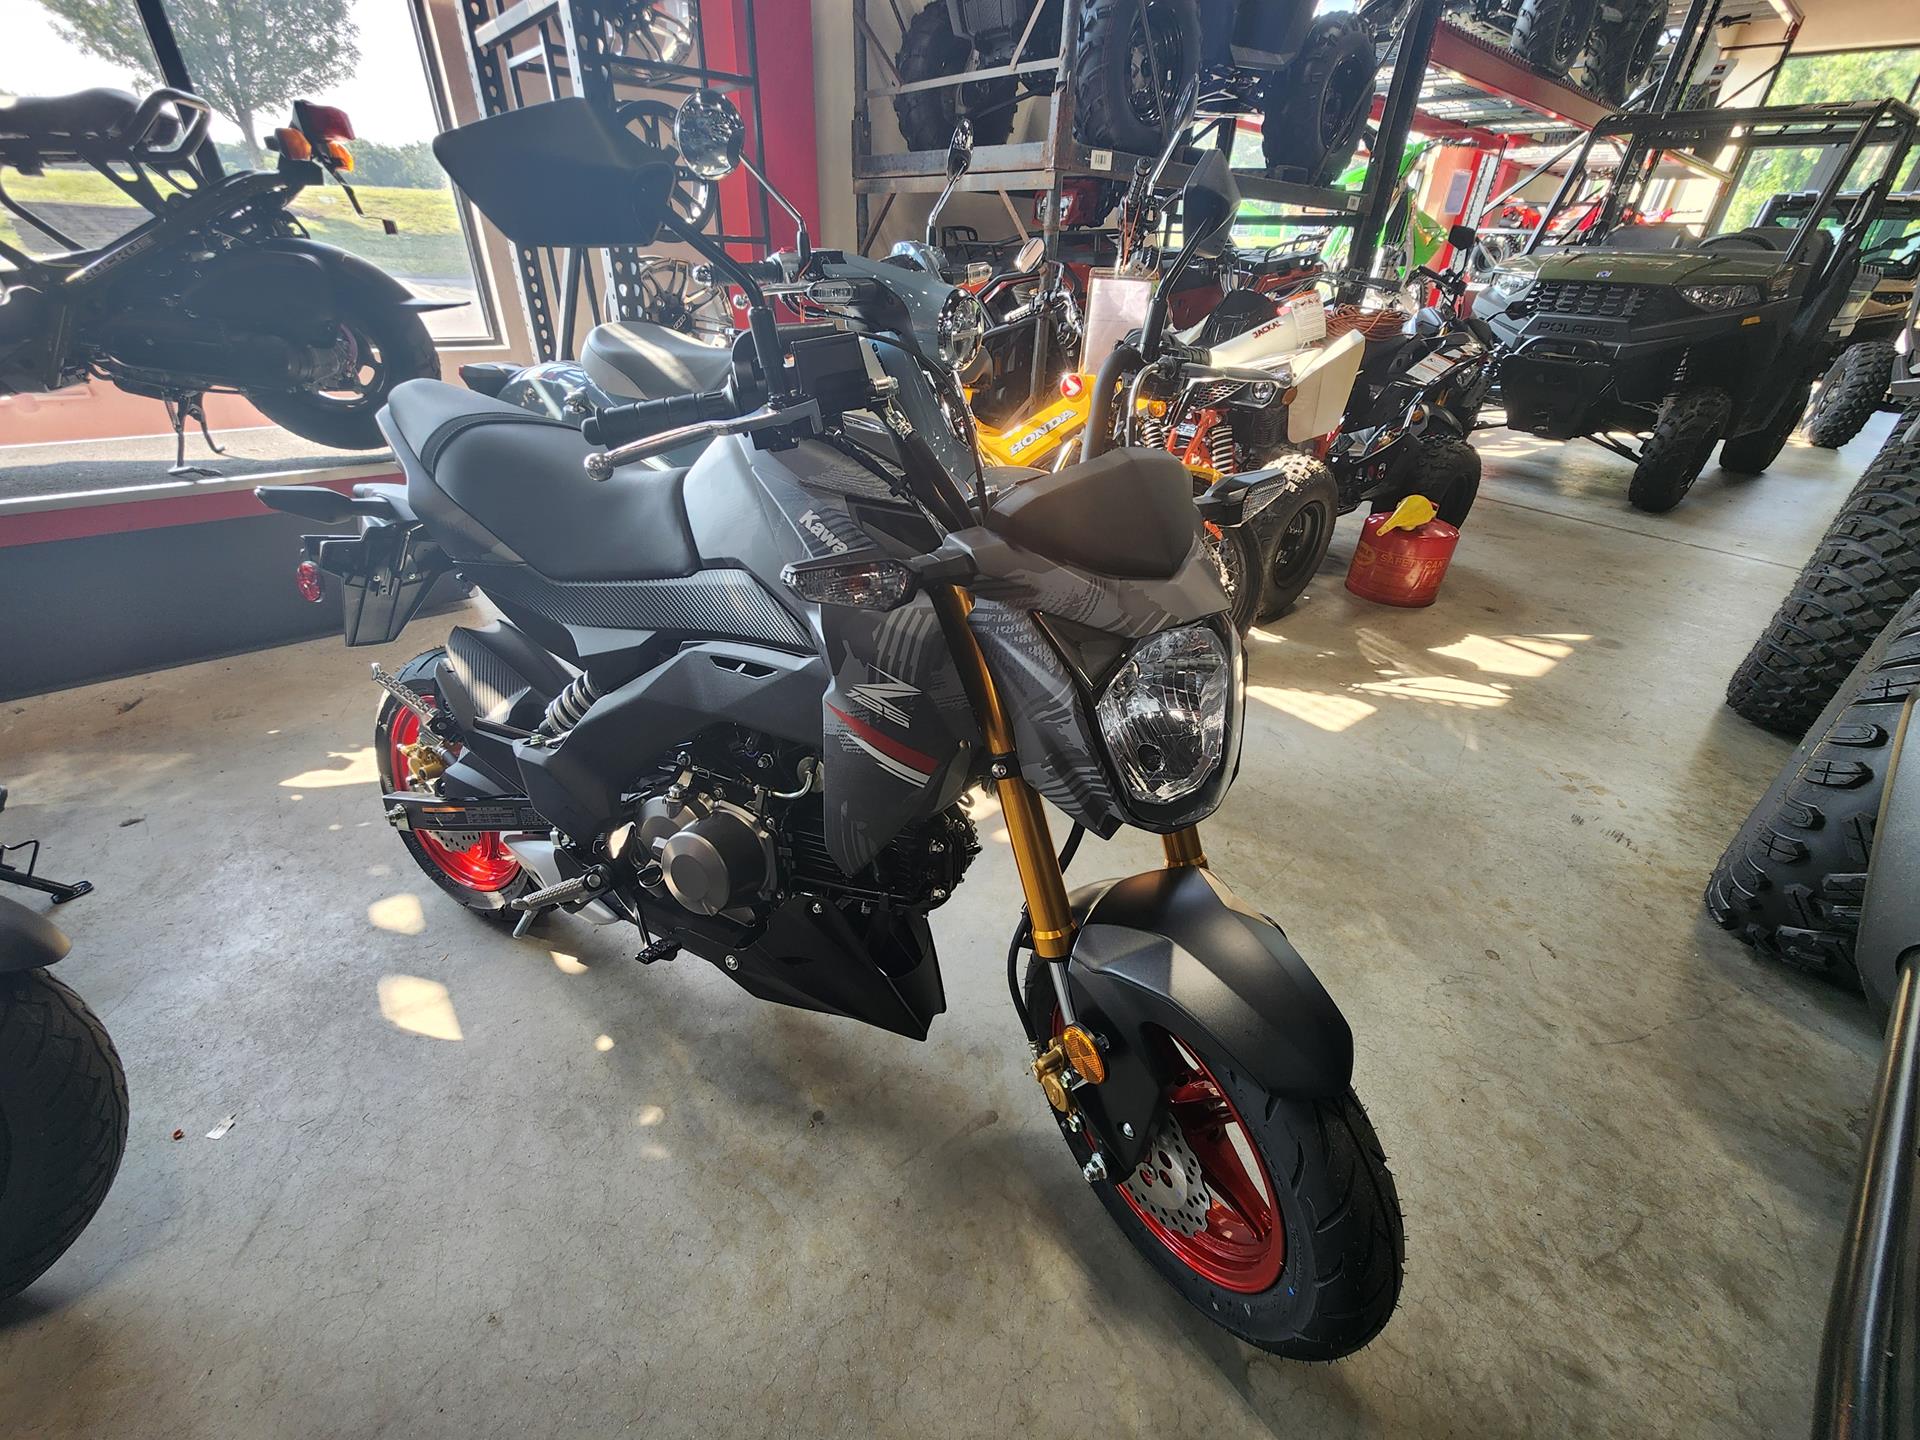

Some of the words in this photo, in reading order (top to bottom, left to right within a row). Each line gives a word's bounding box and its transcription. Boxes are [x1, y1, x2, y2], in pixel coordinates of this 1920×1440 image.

[1537, 321, 1616, 337] POLARIS
[1009, 409, 1078, 457] HONDA
[1380, 552, 1423, 569] SAFETY
[1424, 560, 1444, 569] CAN
